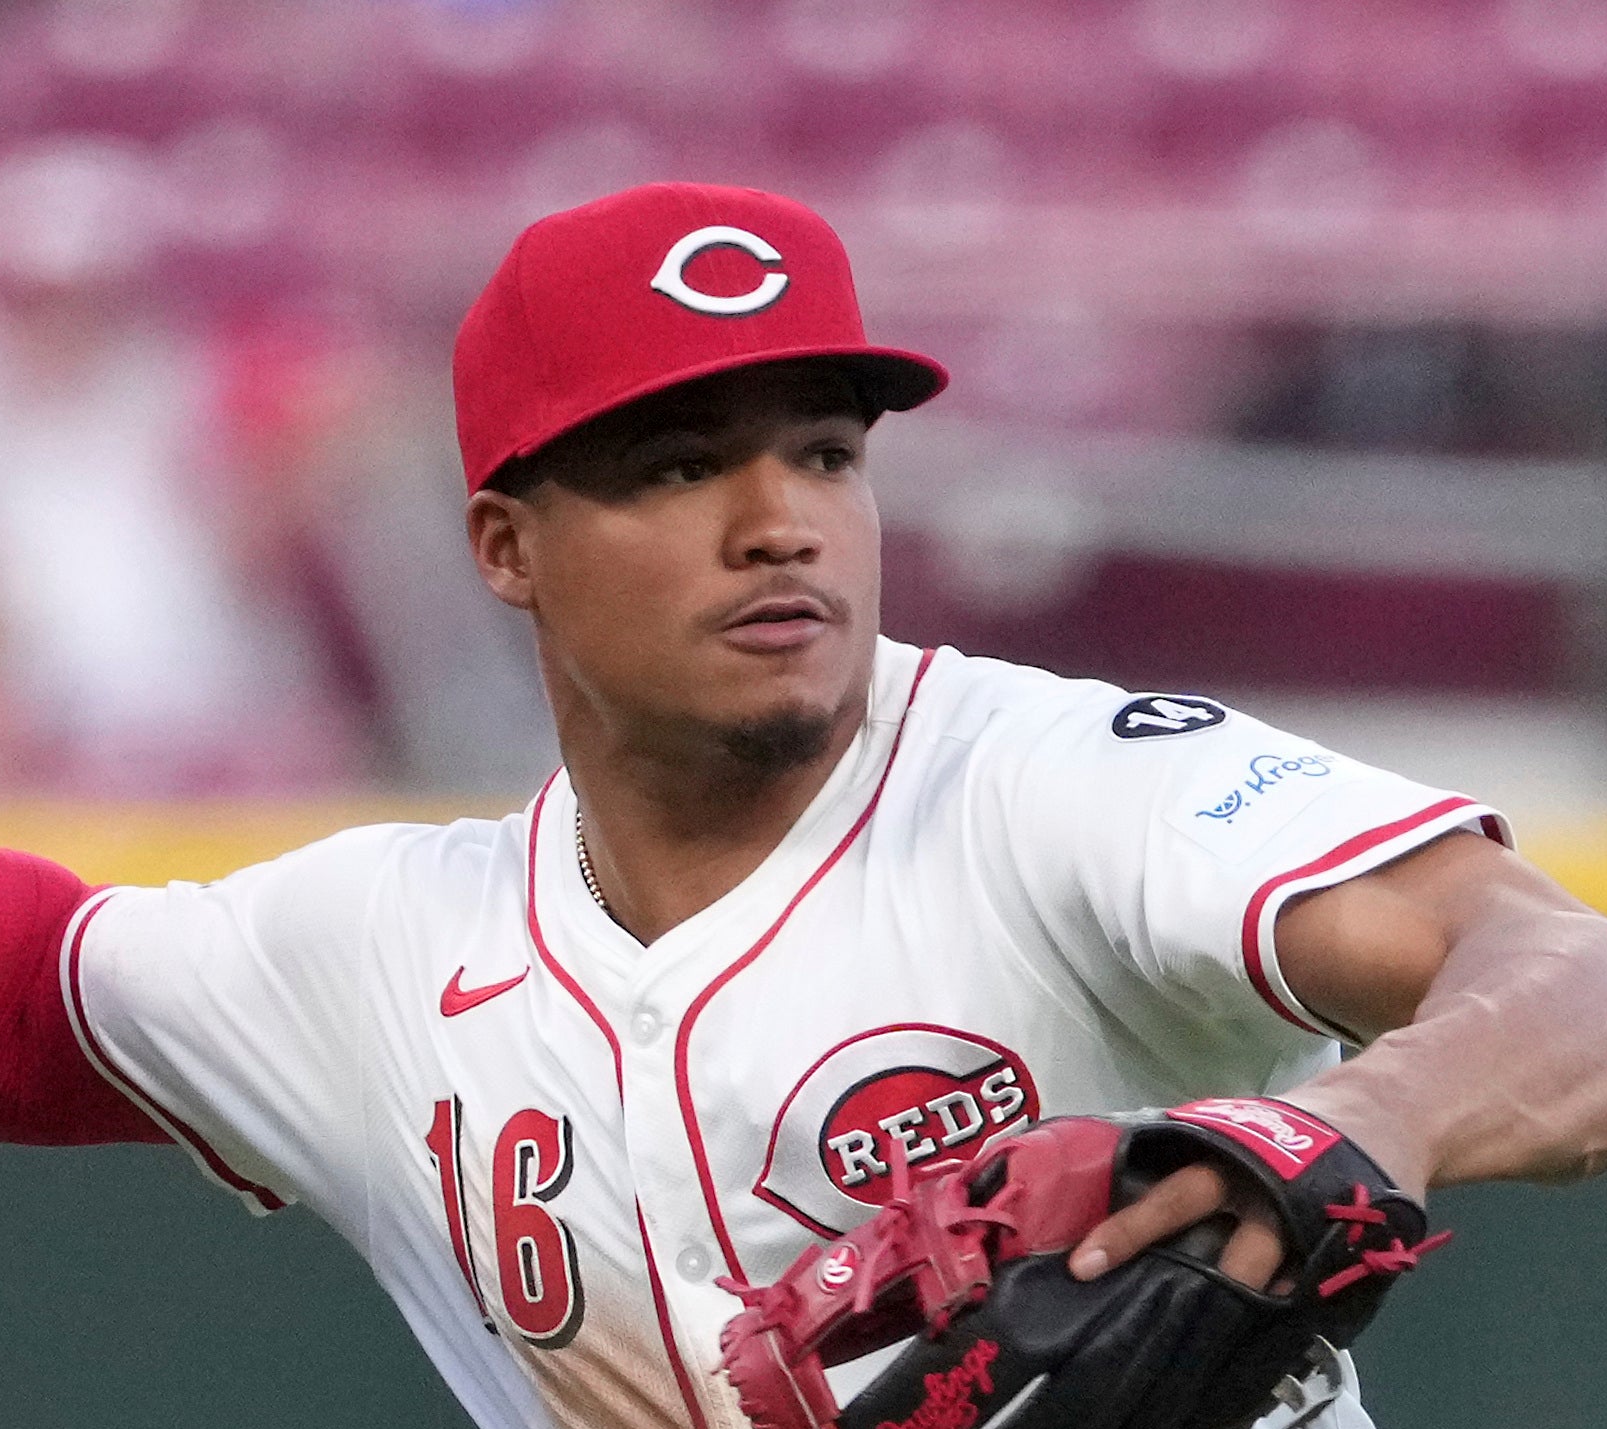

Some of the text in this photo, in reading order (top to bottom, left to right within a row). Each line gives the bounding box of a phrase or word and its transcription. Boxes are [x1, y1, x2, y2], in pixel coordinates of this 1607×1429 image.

[650, 225, 790, 319] C
[1126, 699, 1214, 730] 14
[1245, 754, 1336, 794] Krog
[827, 1067, 1026, 1187] REDS
[424, 1092, 586, 1350] 16
